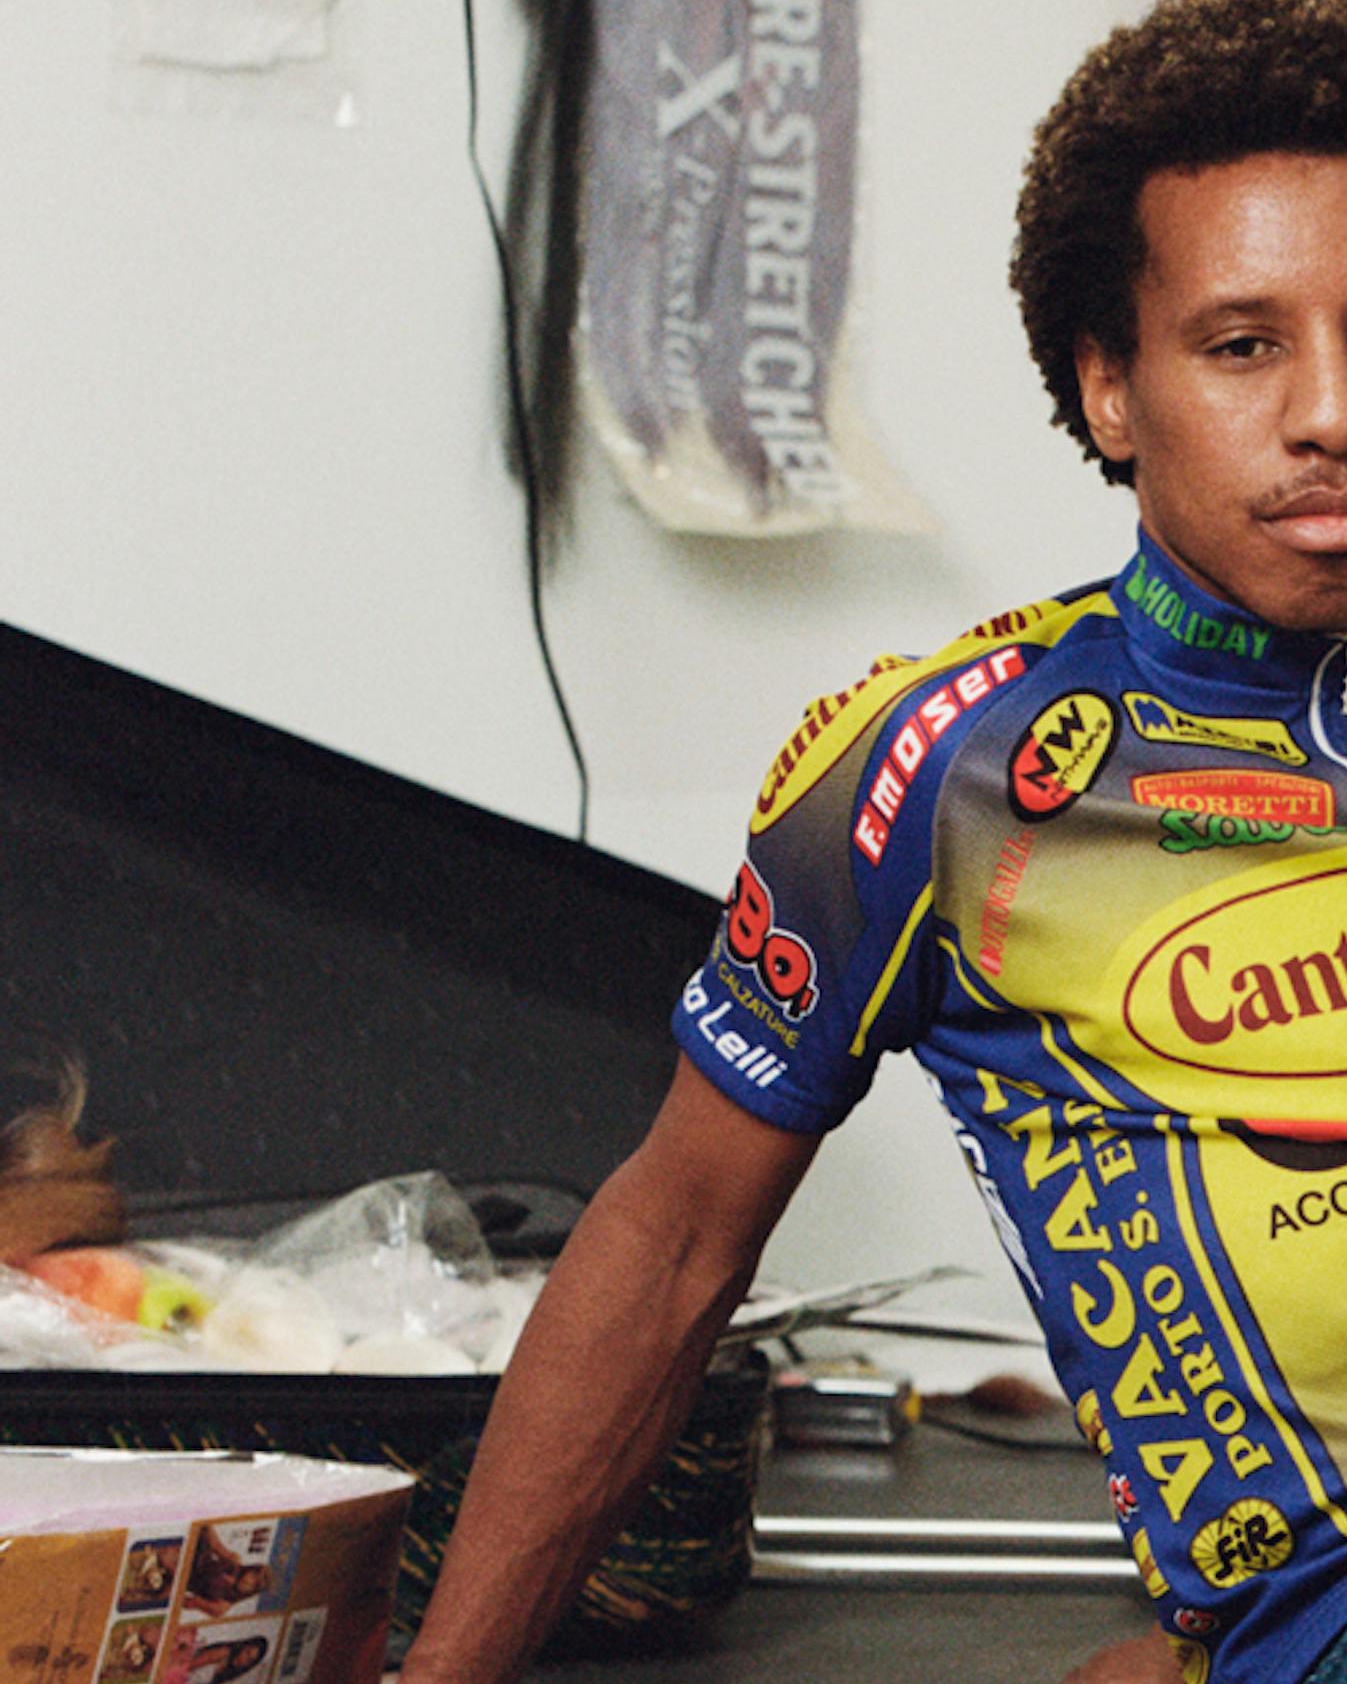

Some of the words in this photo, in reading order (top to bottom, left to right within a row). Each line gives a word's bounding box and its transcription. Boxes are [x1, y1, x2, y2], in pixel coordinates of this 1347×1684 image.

[1142, 581, 1273, 660] HOLIDAY
[1149, 794, 1322, 817] MORETTI
[718, 962, 801, 1050] CALZATURE
[1119, 1189, 1161, 1252] S.
[1143, 1264, 1274, 1481] PORTO
